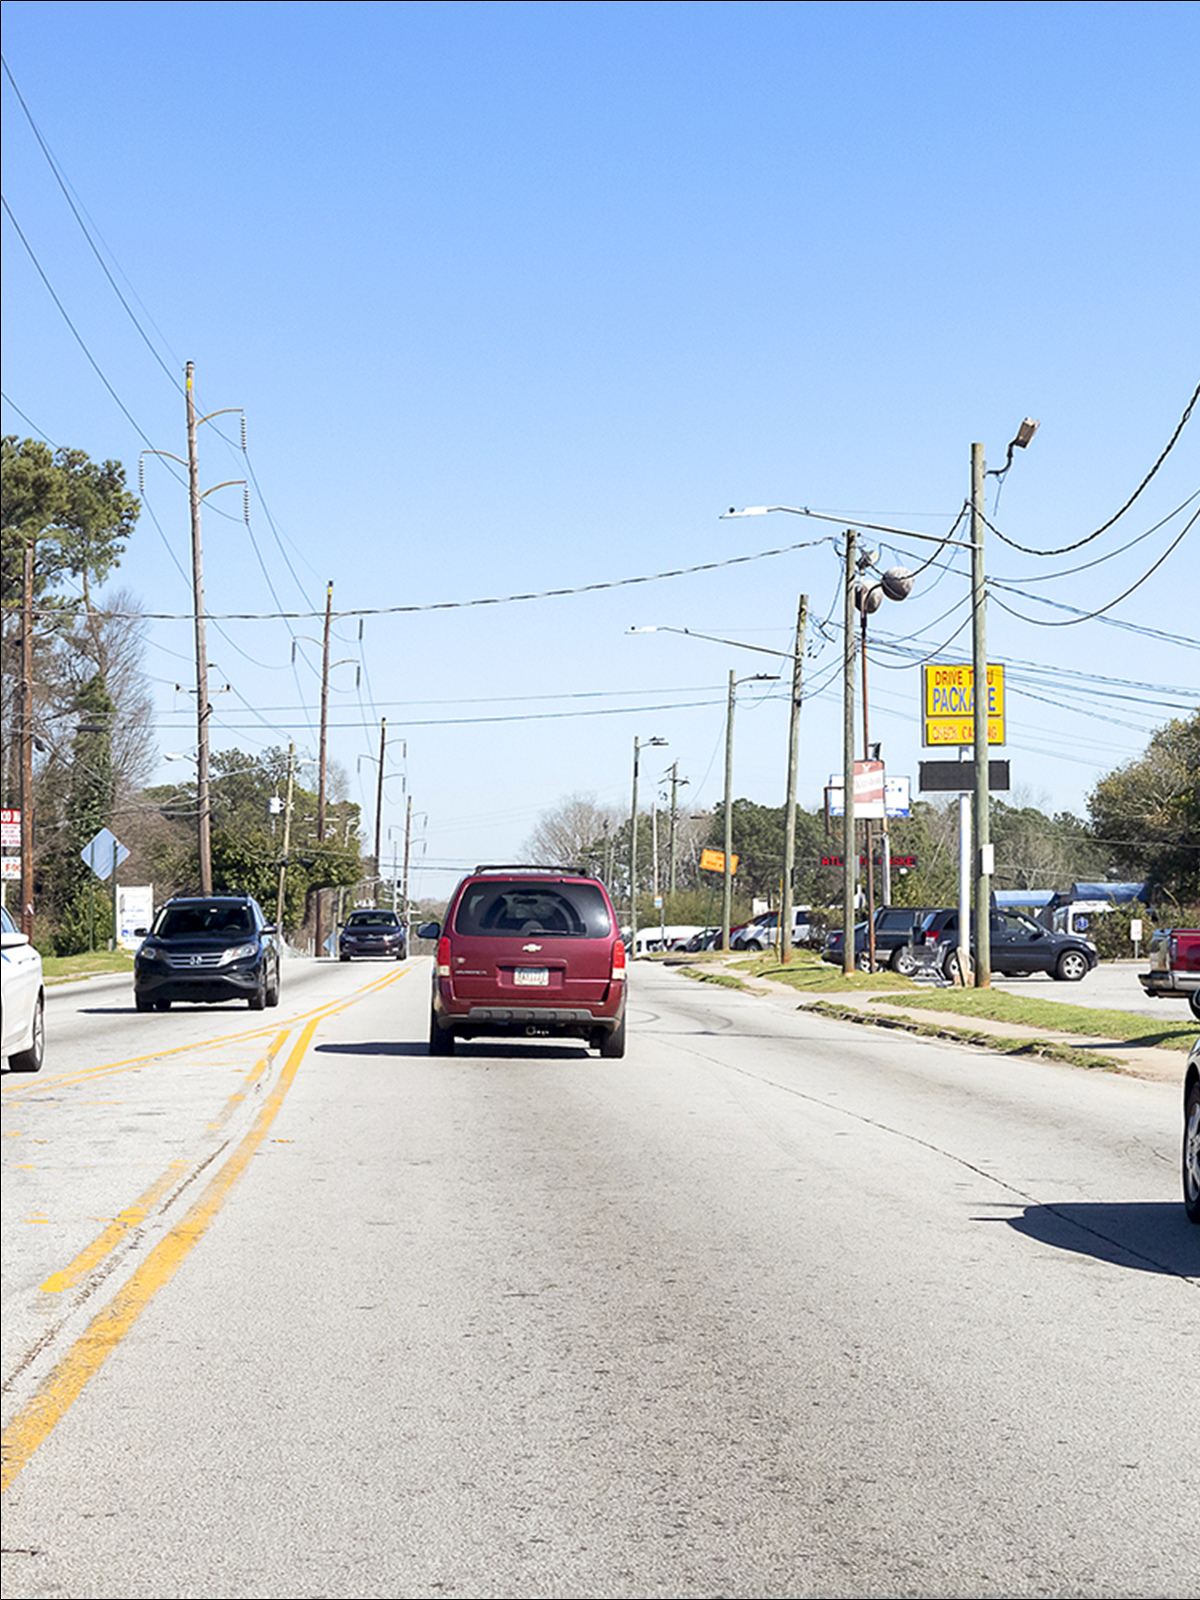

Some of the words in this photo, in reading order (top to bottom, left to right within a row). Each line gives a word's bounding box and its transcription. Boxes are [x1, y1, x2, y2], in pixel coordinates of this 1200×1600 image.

[935, 670, 963, 686] DRIVE
[967, 670, 994, 686] TU
[933, 686, 996, 713] PACKAE
